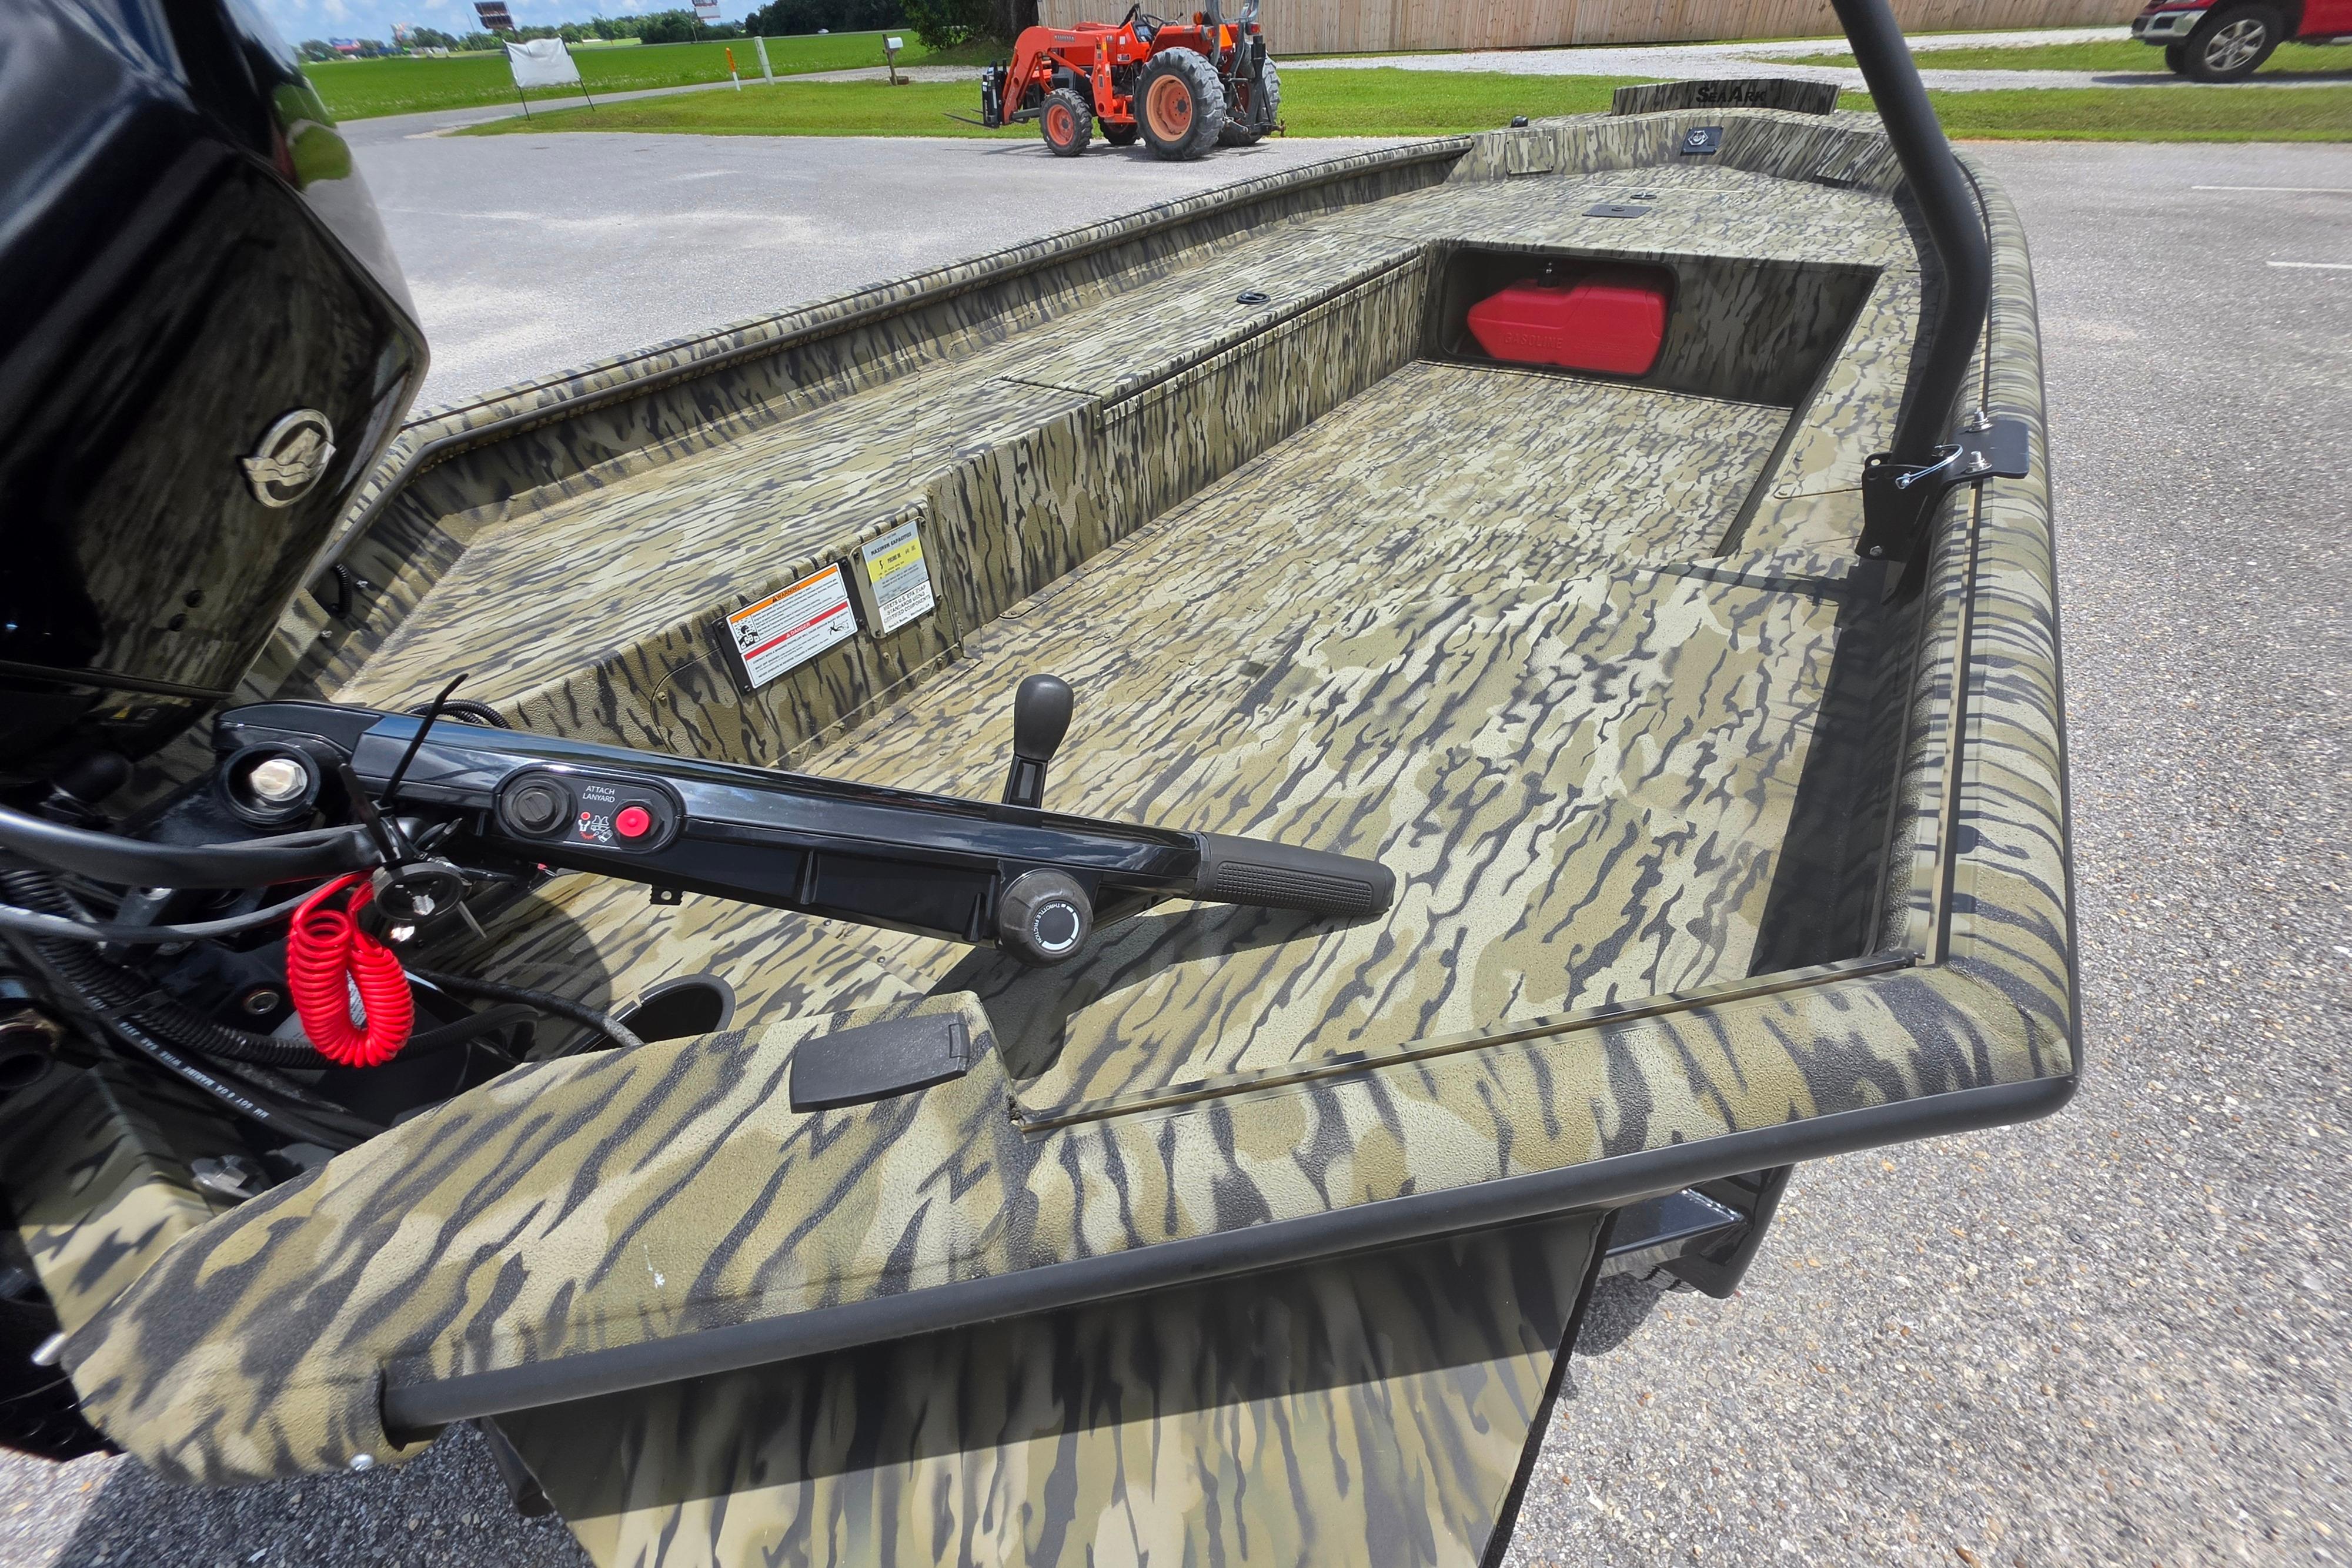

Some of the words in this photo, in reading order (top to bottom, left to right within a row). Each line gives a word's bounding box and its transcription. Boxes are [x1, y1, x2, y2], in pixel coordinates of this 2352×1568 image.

[1505, 333, 1563, 349] GASOLINE
[871, 543, 890, 556] MAXIMUM
[891, 531, 911, 546] CAPACITIES
[776, 584, 800, 600] WARNING
[883, 600, 898, 611] MEETS
[887, 599, 912, 615] STANDARDS
[904, 594, 931, 612] COMPONENTS
[790, 621, 811, 636] DANGER
[582, 793, 616, 803] LANYARD
[586, 785, 615, 795] ATTACH
[1036, 903, 1060, 920] THROTTLE
[1034, 919, 1043, 944] FRICTION
[159, 1051, 182, 1066] WIRE
[182, 1065, 216, 1086] MARINE
